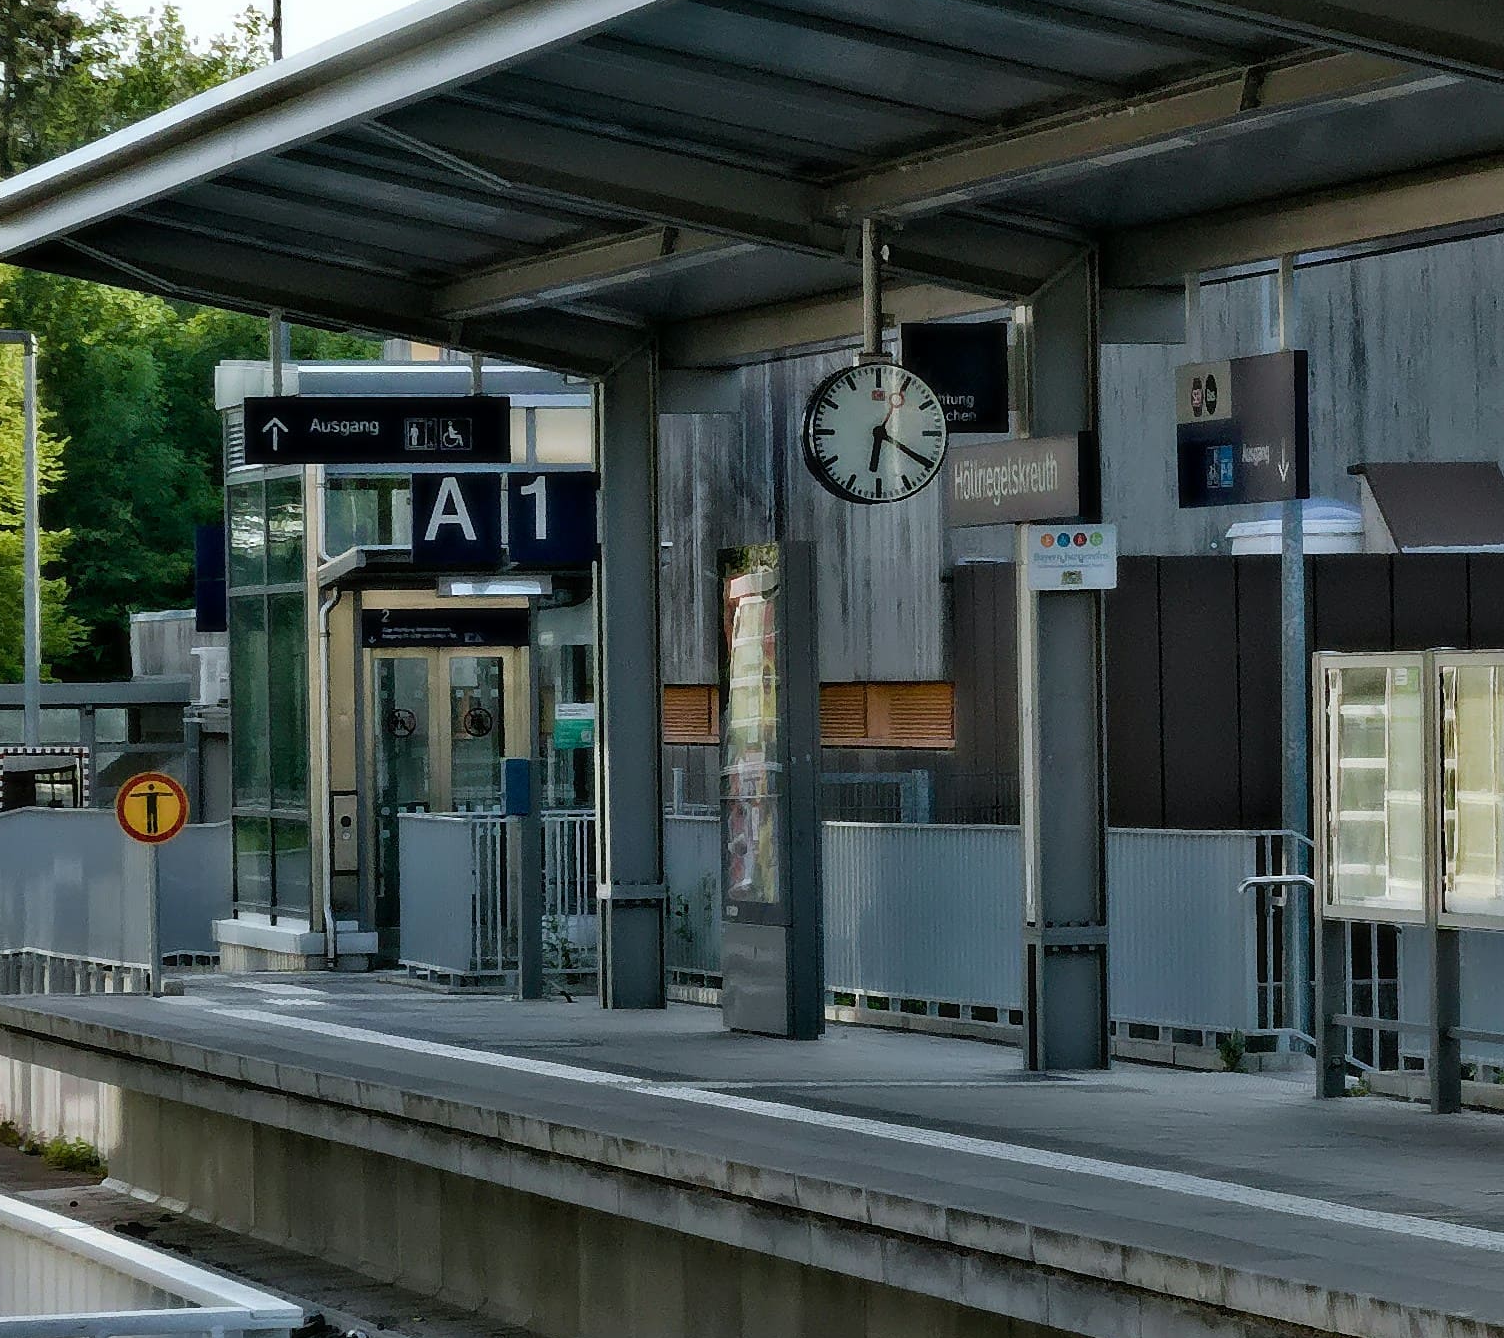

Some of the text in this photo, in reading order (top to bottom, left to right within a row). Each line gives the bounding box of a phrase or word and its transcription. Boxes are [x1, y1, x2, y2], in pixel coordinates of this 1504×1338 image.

[946, 409, 977, 422] chen
[309, 418, 380, 436] Ausgang
[423, 475, 547, 541] A 1
[380, 609, 391, 623] 2
